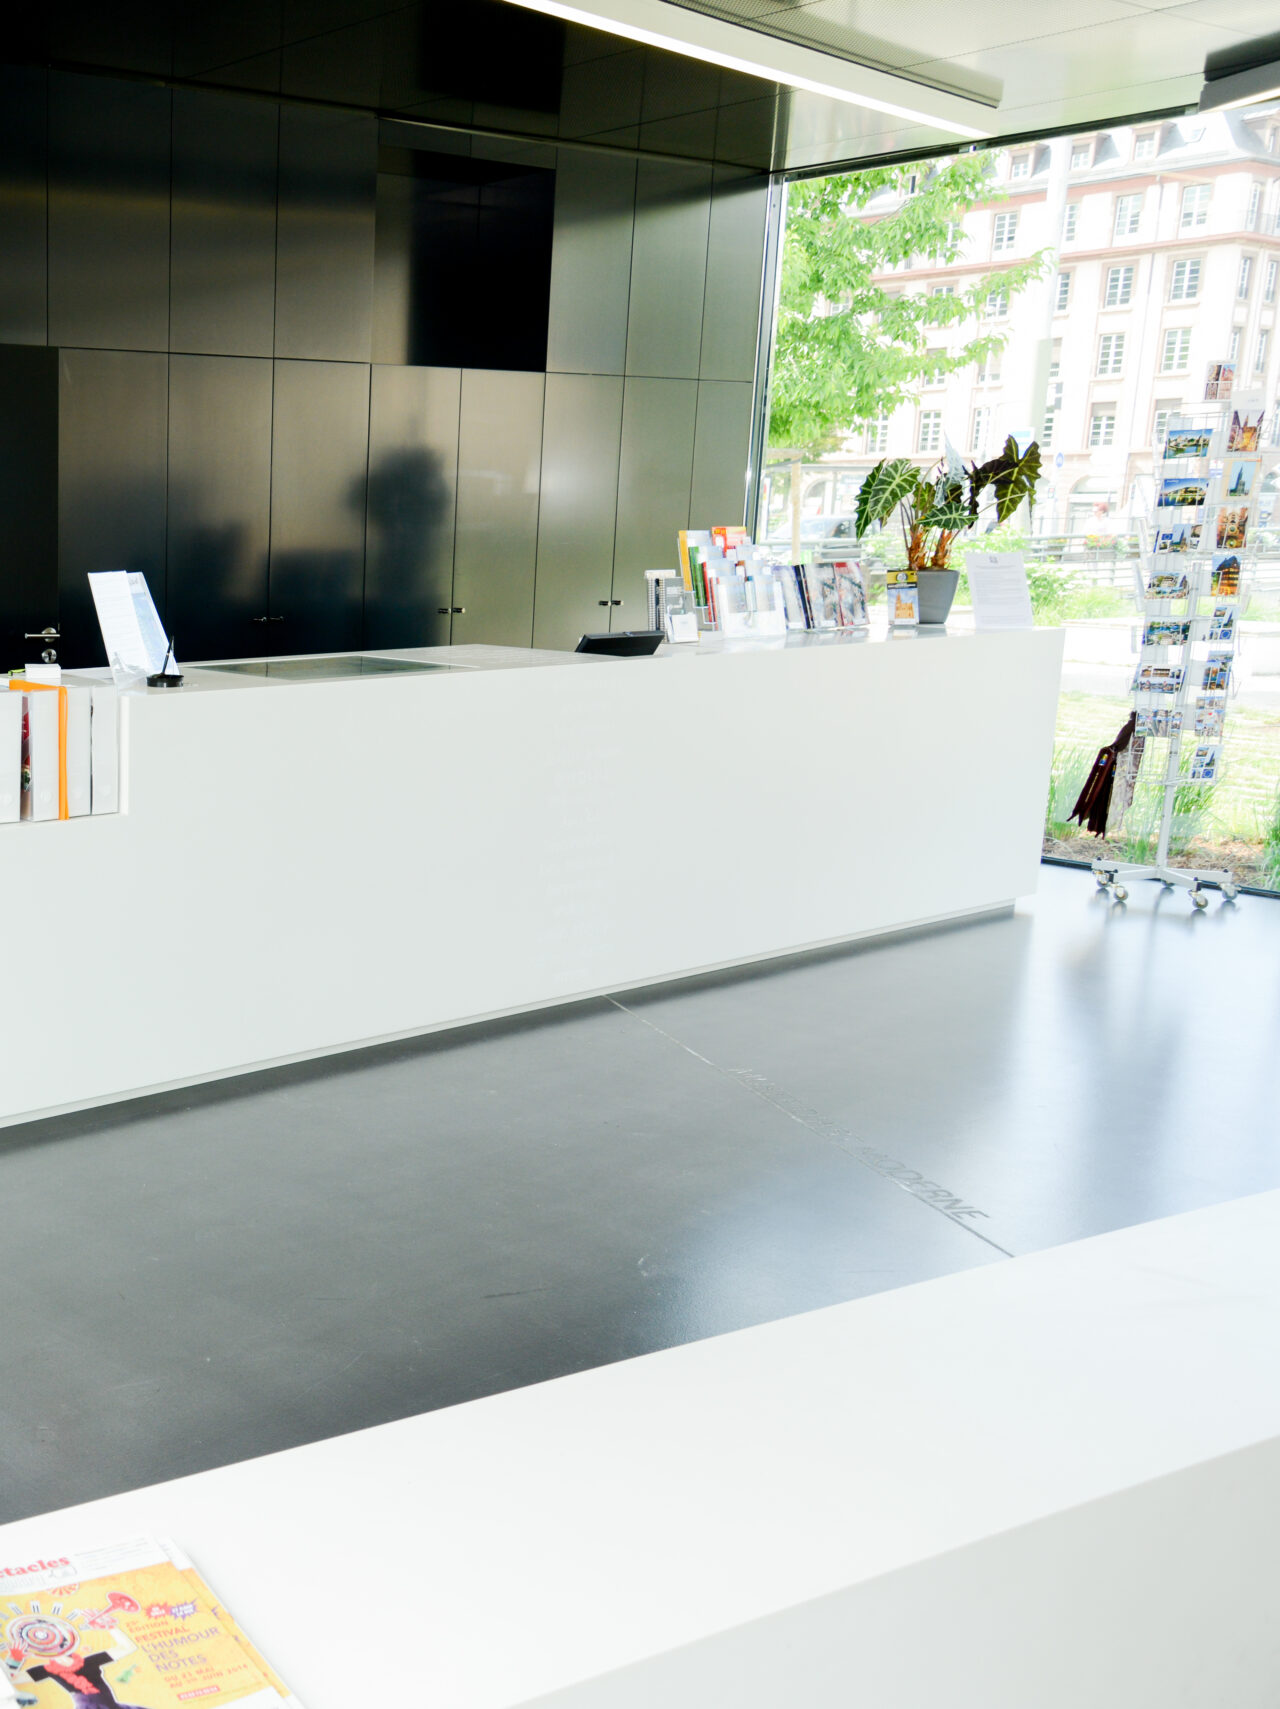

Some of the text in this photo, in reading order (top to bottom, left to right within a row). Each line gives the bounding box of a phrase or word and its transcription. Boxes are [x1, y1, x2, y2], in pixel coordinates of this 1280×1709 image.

[135, 1625, 191, 1643] FESTIVAL
[141, 1626, 220, 1653] L'HUMOUR
[148, 1649, 179, 1663] DES
[155, 1653, 207, 1673] NOTES
